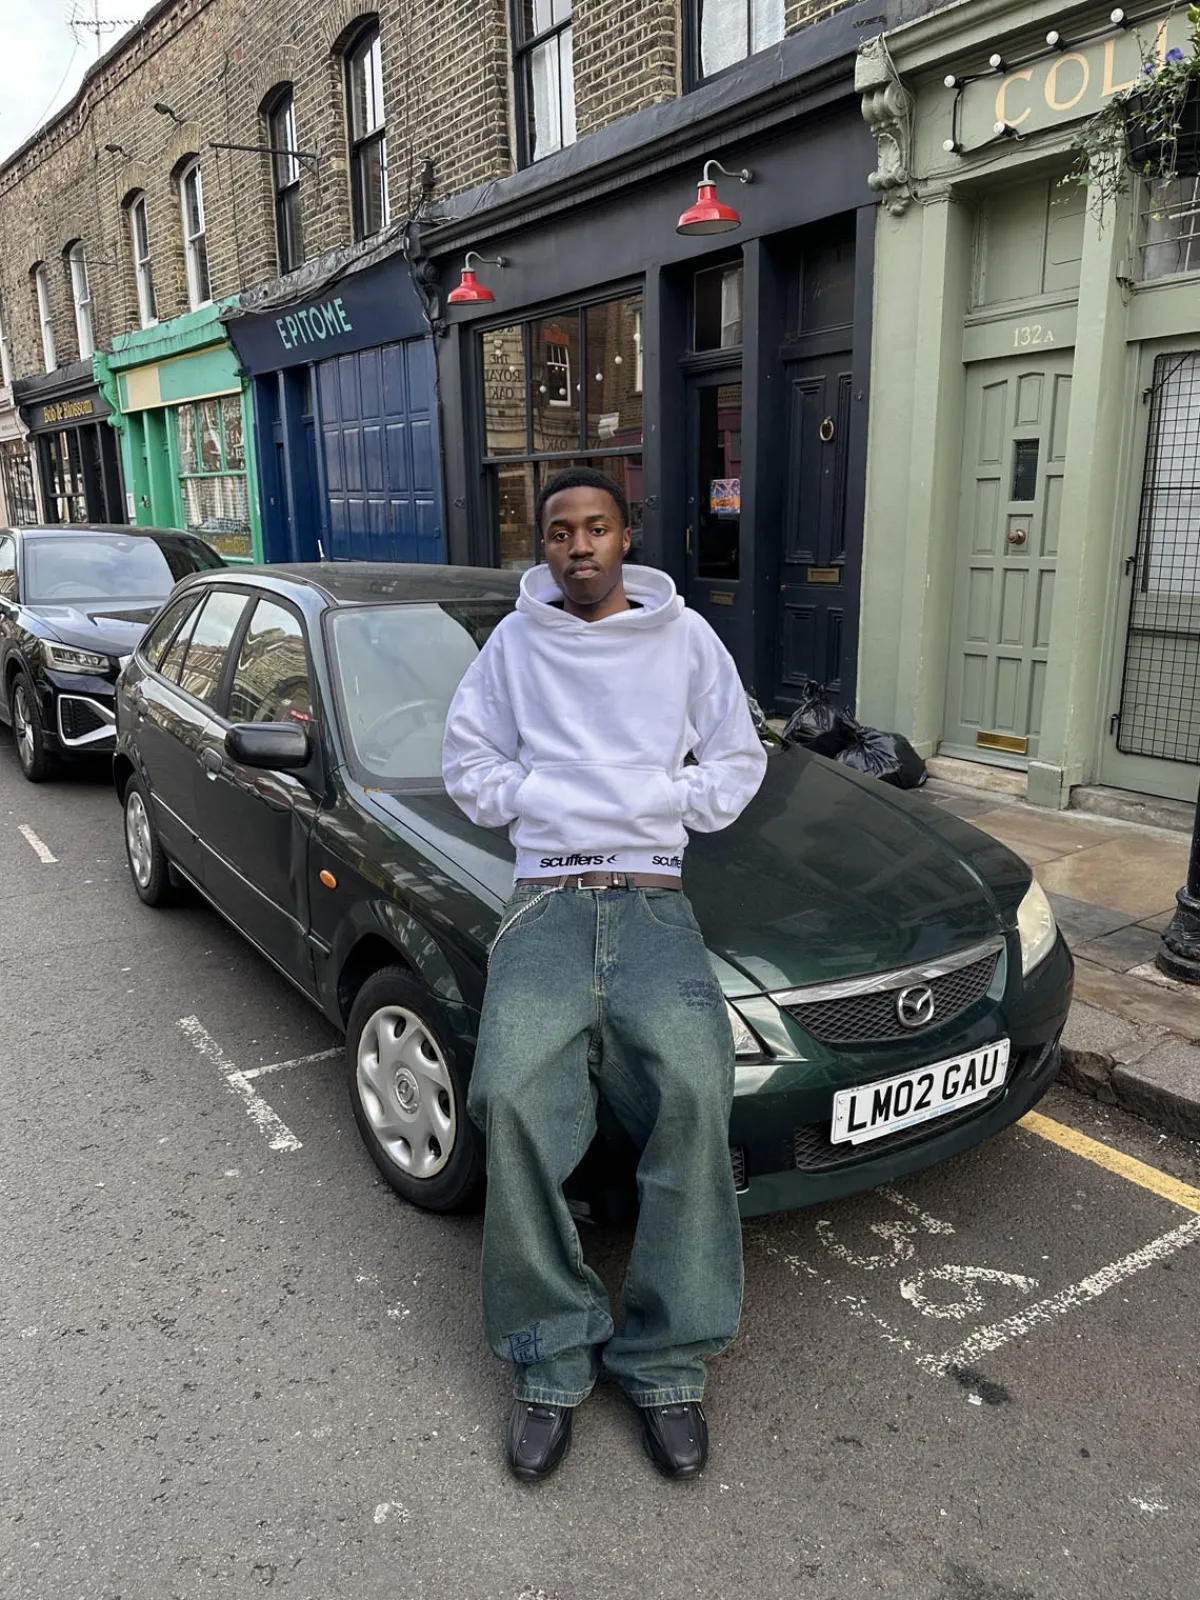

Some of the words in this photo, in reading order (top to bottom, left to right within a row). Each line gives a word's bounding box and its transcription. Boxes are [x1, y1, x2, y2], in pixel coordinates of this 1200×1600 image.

[275, 297, 353, 350] EPITOME
[1013, 324, 1056, 347] 132A
[43, 406, 56, 423] Bob
[56, 403, 63, 420] &
[539, 853, 604, 868] scuffers
[847, 1073, 935, 1133] LM02
[942, 1049, 999, 1101] GAU
